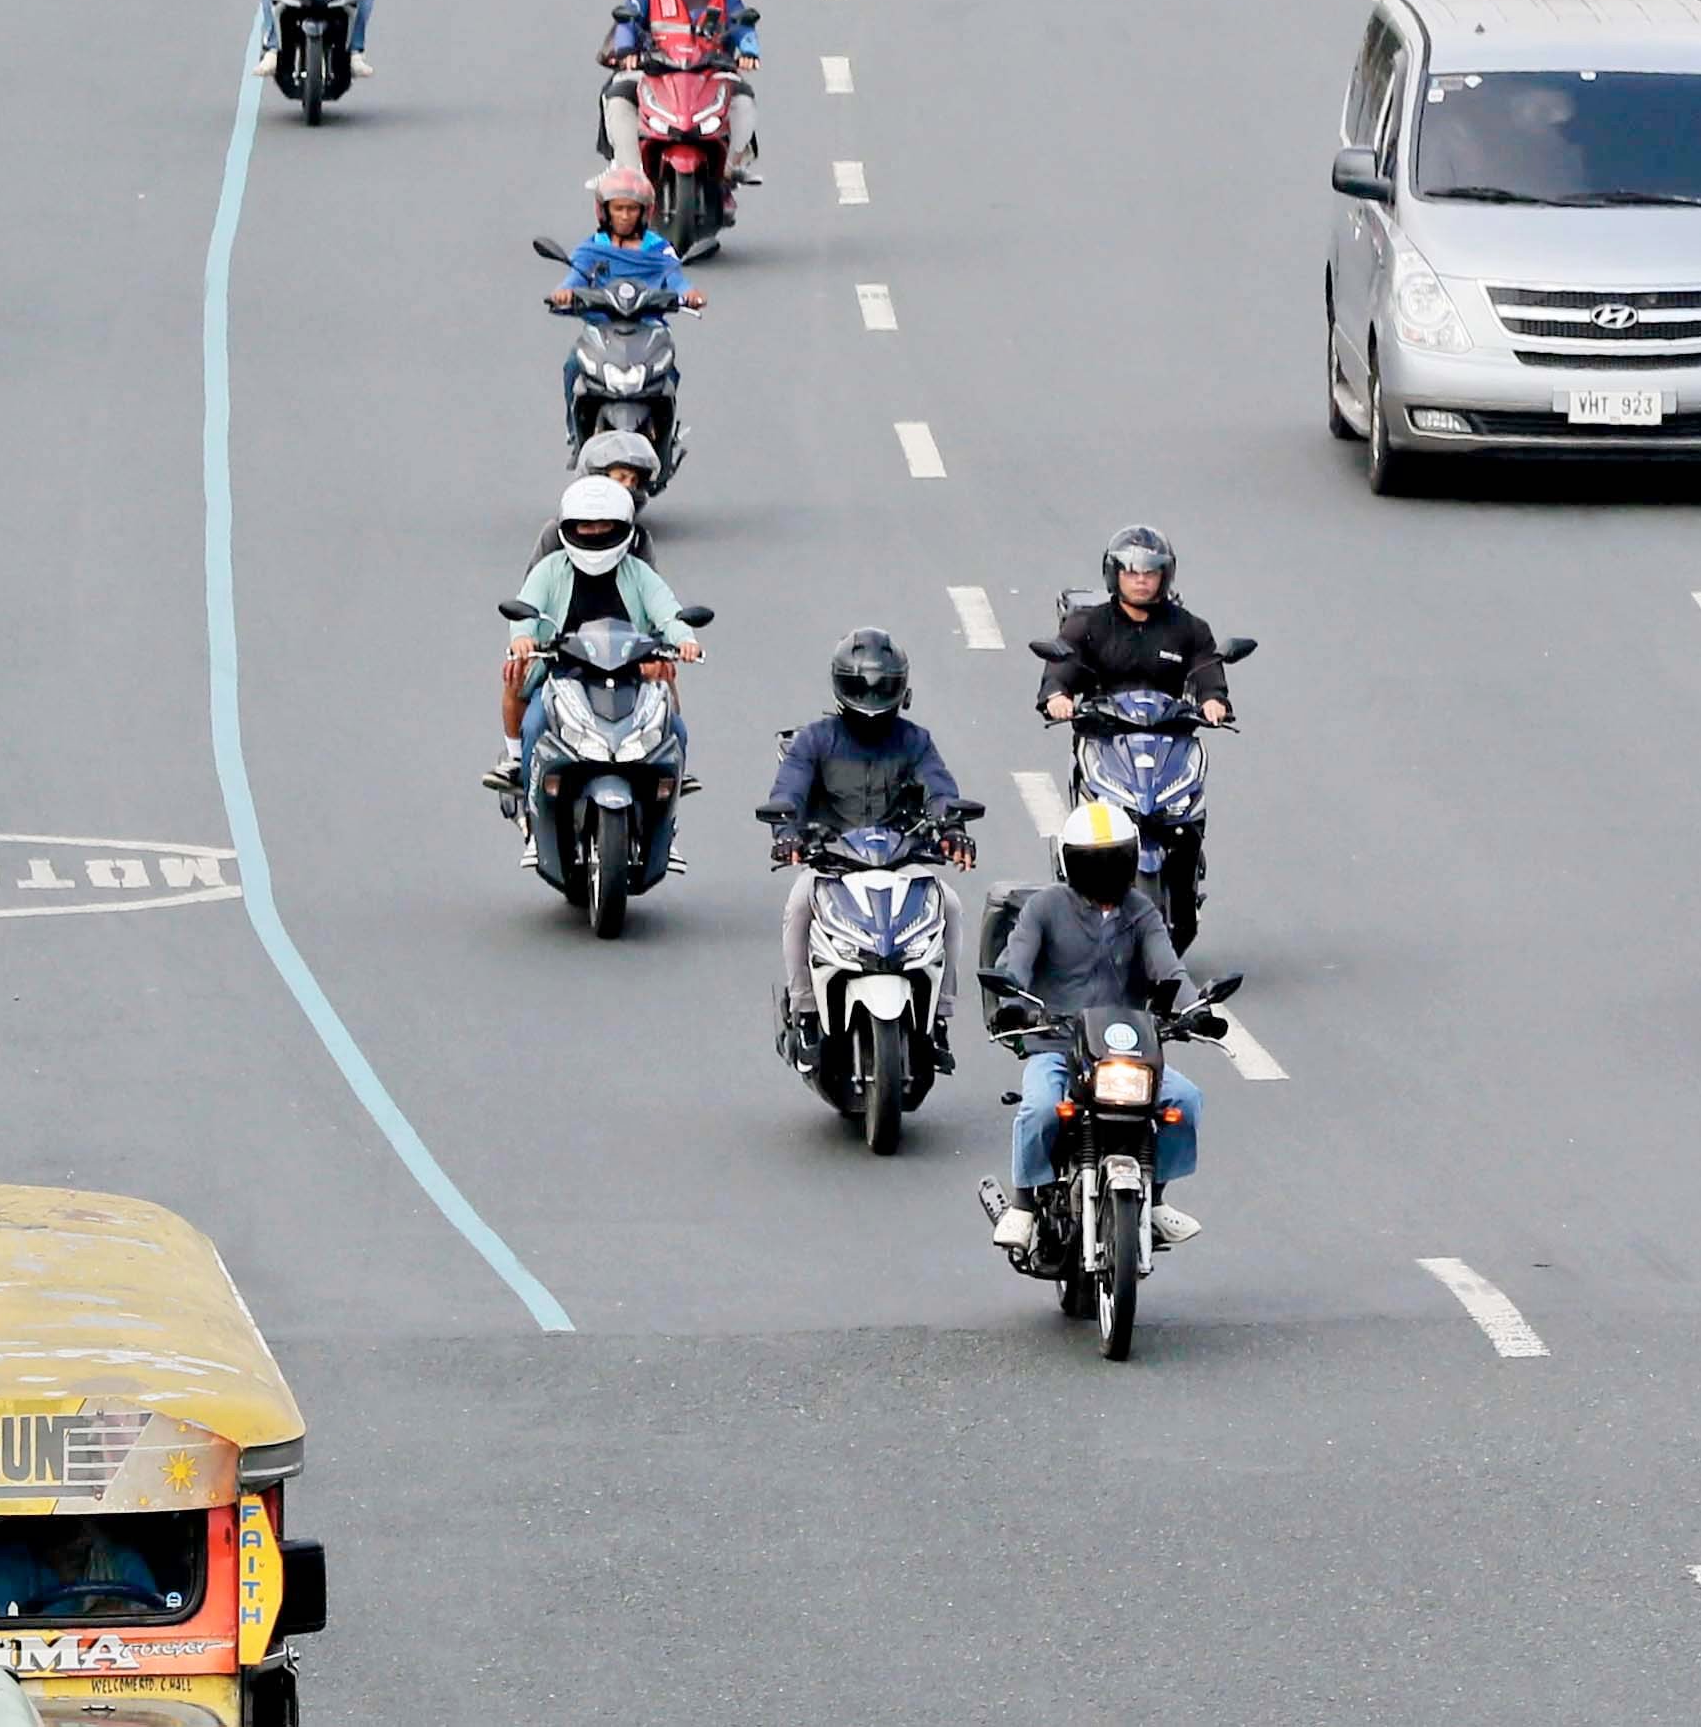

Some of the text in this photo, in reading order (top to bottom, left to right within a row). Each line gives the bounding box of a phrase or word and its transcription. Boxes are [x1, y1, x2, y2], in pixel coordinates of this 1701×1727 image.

[1579, 396, 1653, 415] VHT 923
[241, 1505, 262, 1625] FAITH
